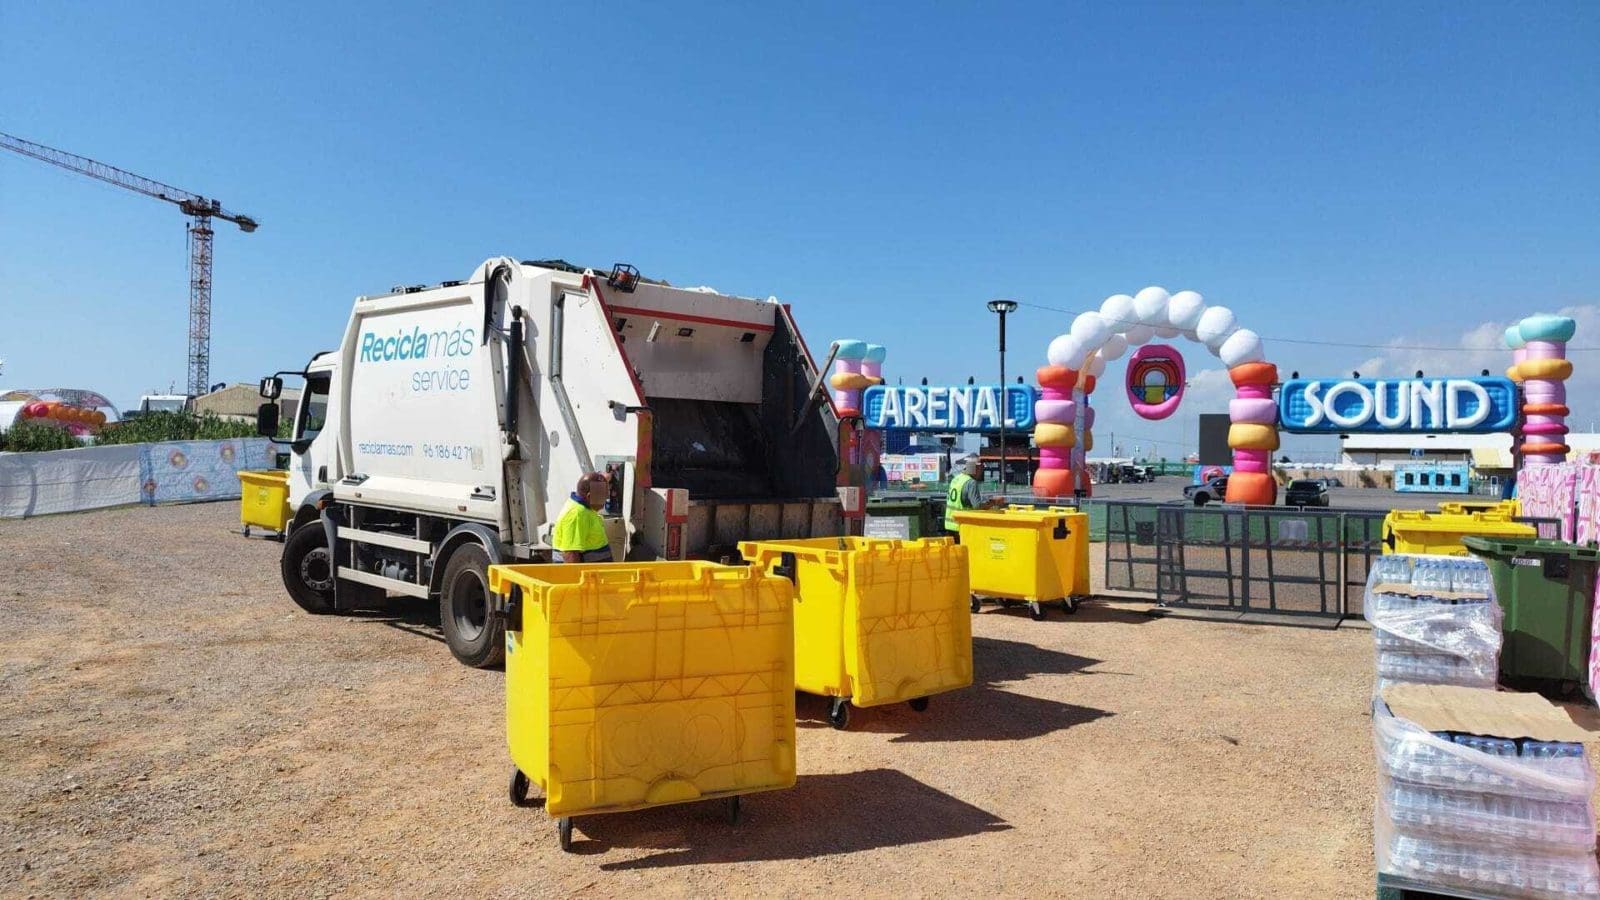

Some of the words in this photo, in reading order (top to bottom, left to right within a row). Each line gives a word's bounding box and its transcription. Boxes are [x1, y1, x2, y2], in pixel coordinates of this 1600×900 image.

[361, 322, 475, 362] Reciclamás
[412, 364, 470, 391] service
[878, 386, 1016, 428] ARENAL
[1304, 380, 1491, 429] SOUND
[359, 440, 414, 456] reciclamas.com
[423, 444, 433, 457] 96
[435, 444, 450, 459] 186
[452, 445, 463, 459] 42
